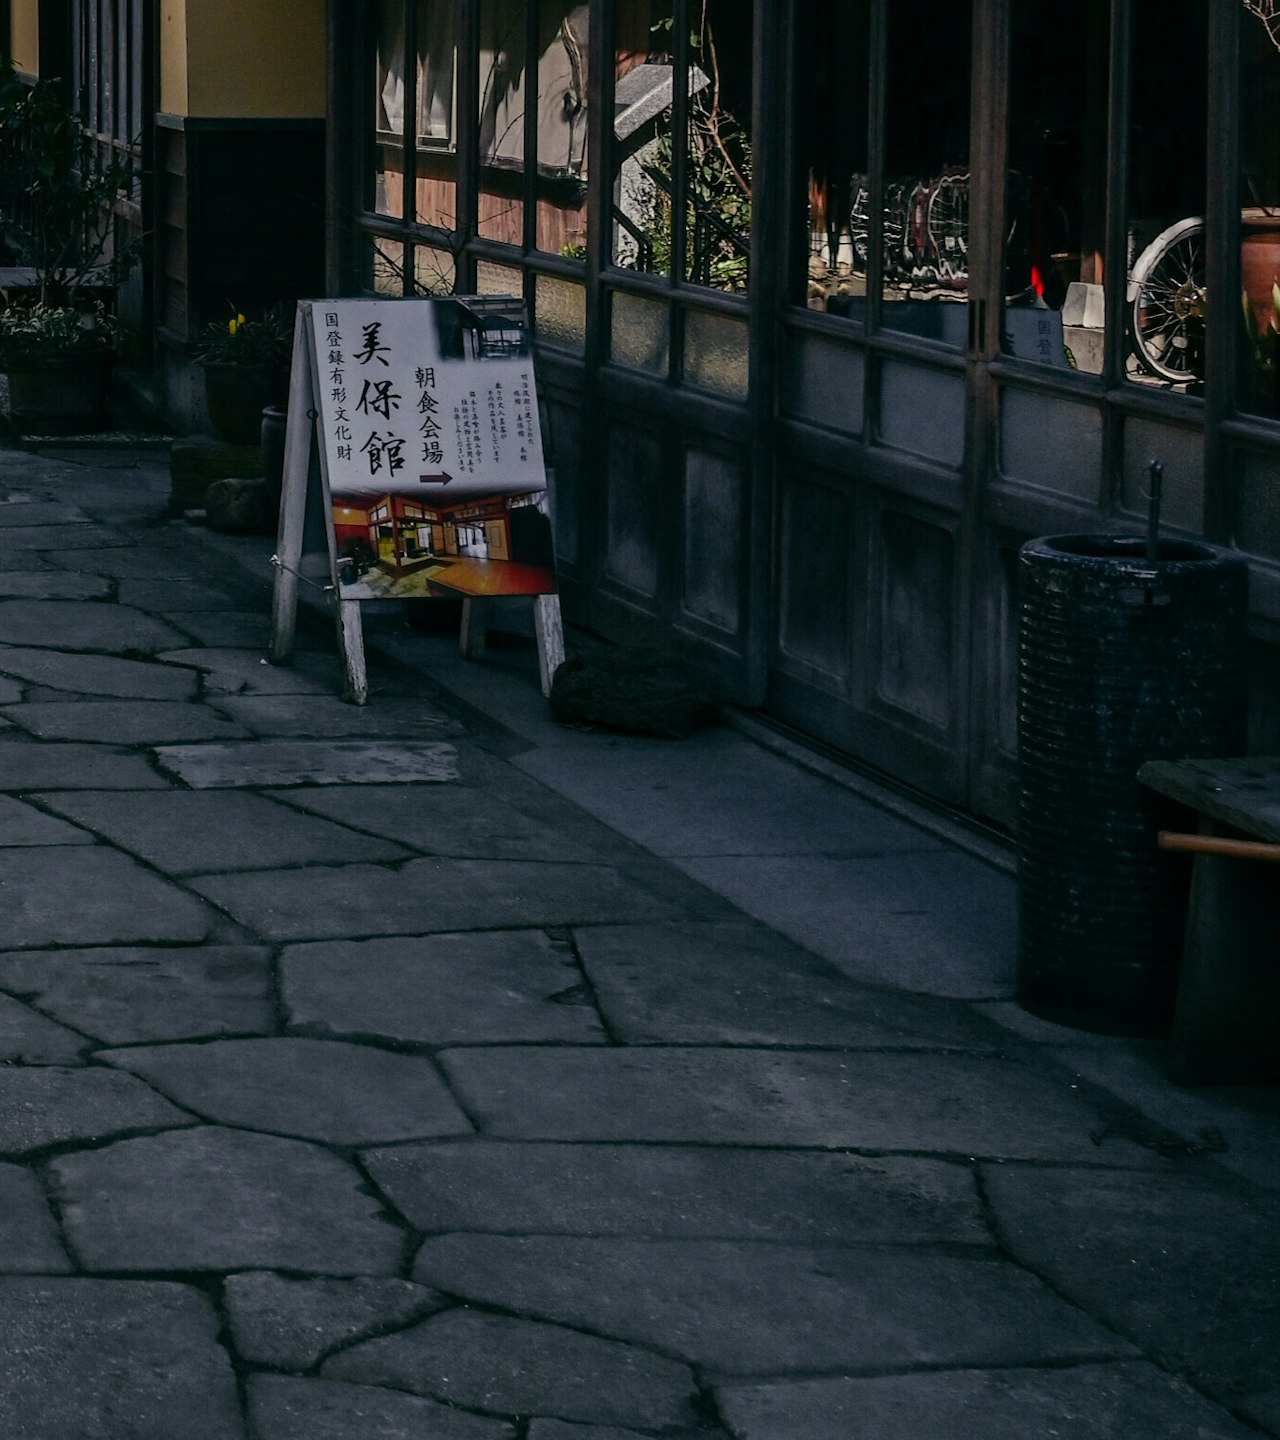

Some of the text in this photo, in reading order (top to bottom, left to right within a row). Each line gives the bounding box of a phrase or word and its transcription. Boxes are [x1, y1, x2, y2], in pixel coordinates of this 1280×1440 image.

[325, 312, 353, 461] 国登録有形文化財
[352, 322, 407, 478] 美保館
[414, 366, 443, 465] 朝食会場
